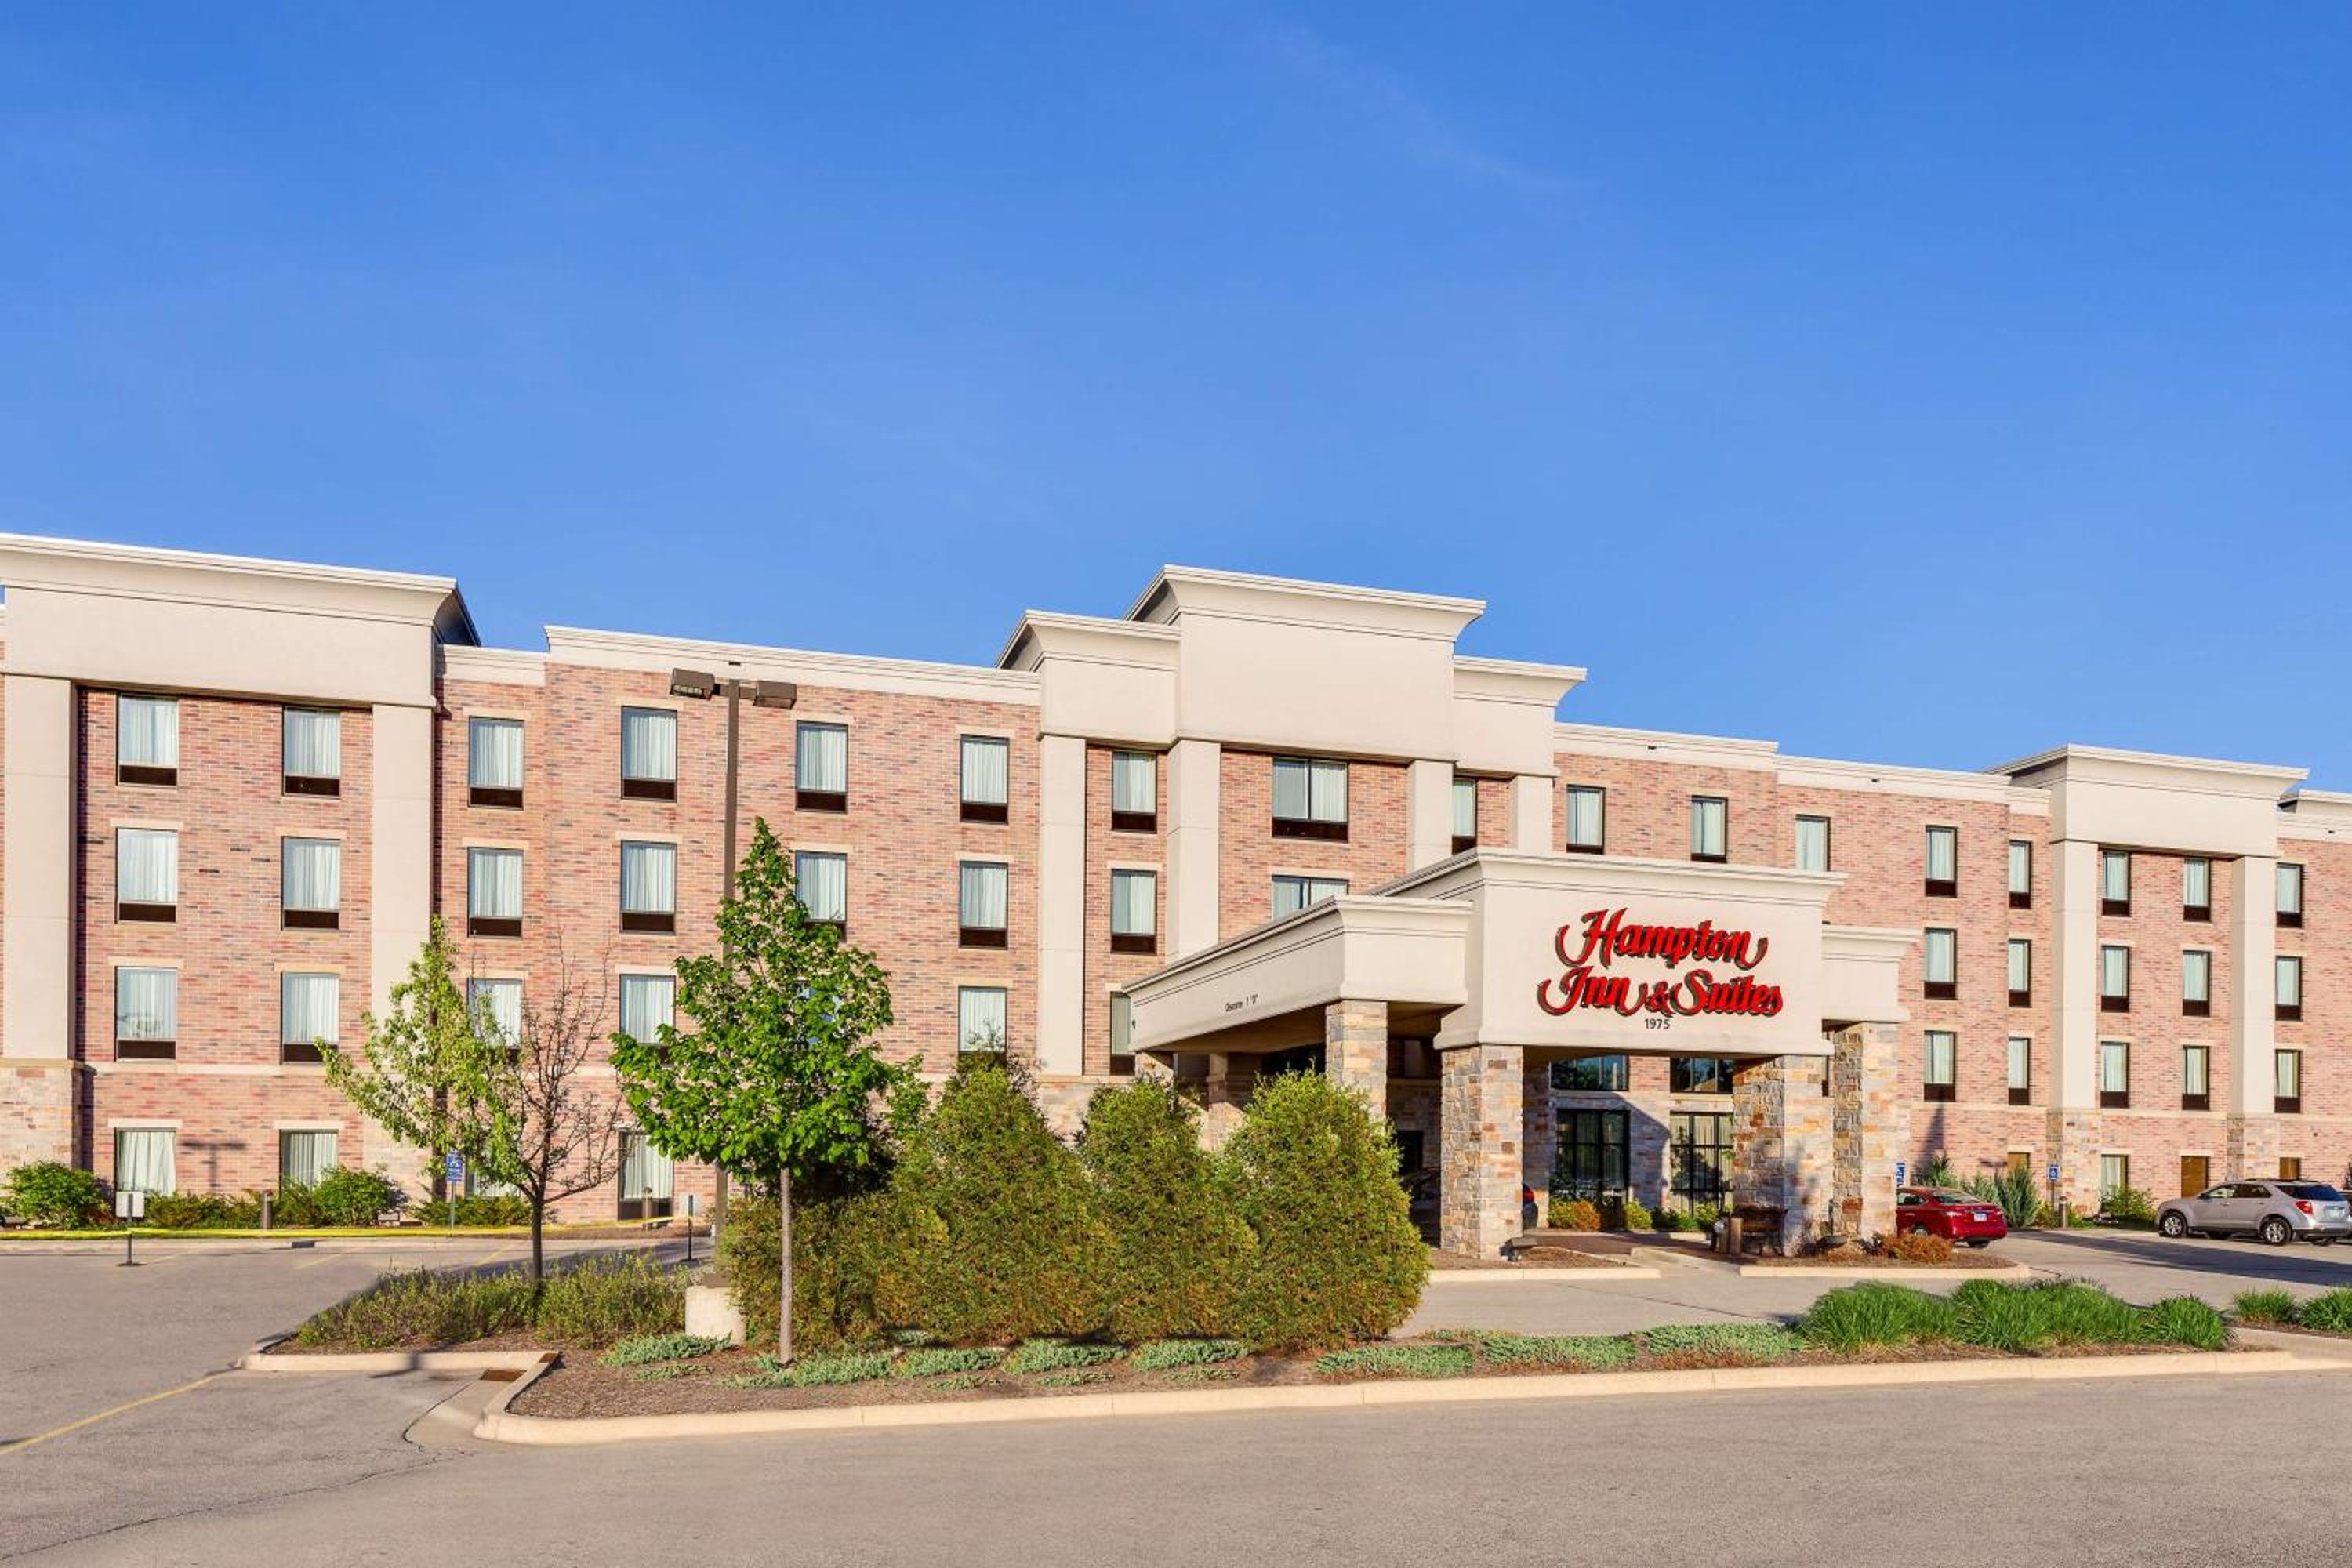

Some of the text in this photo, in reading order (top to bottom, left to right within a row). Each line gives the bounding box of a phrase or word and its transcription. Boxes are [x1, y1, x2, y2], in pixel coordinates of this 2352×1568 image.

[1555, 907, 1769, 970] Hampton
[1537, 966, 1783, 1018] Inn & Suites
[1644, 1018, 1671, 1029] 1975
